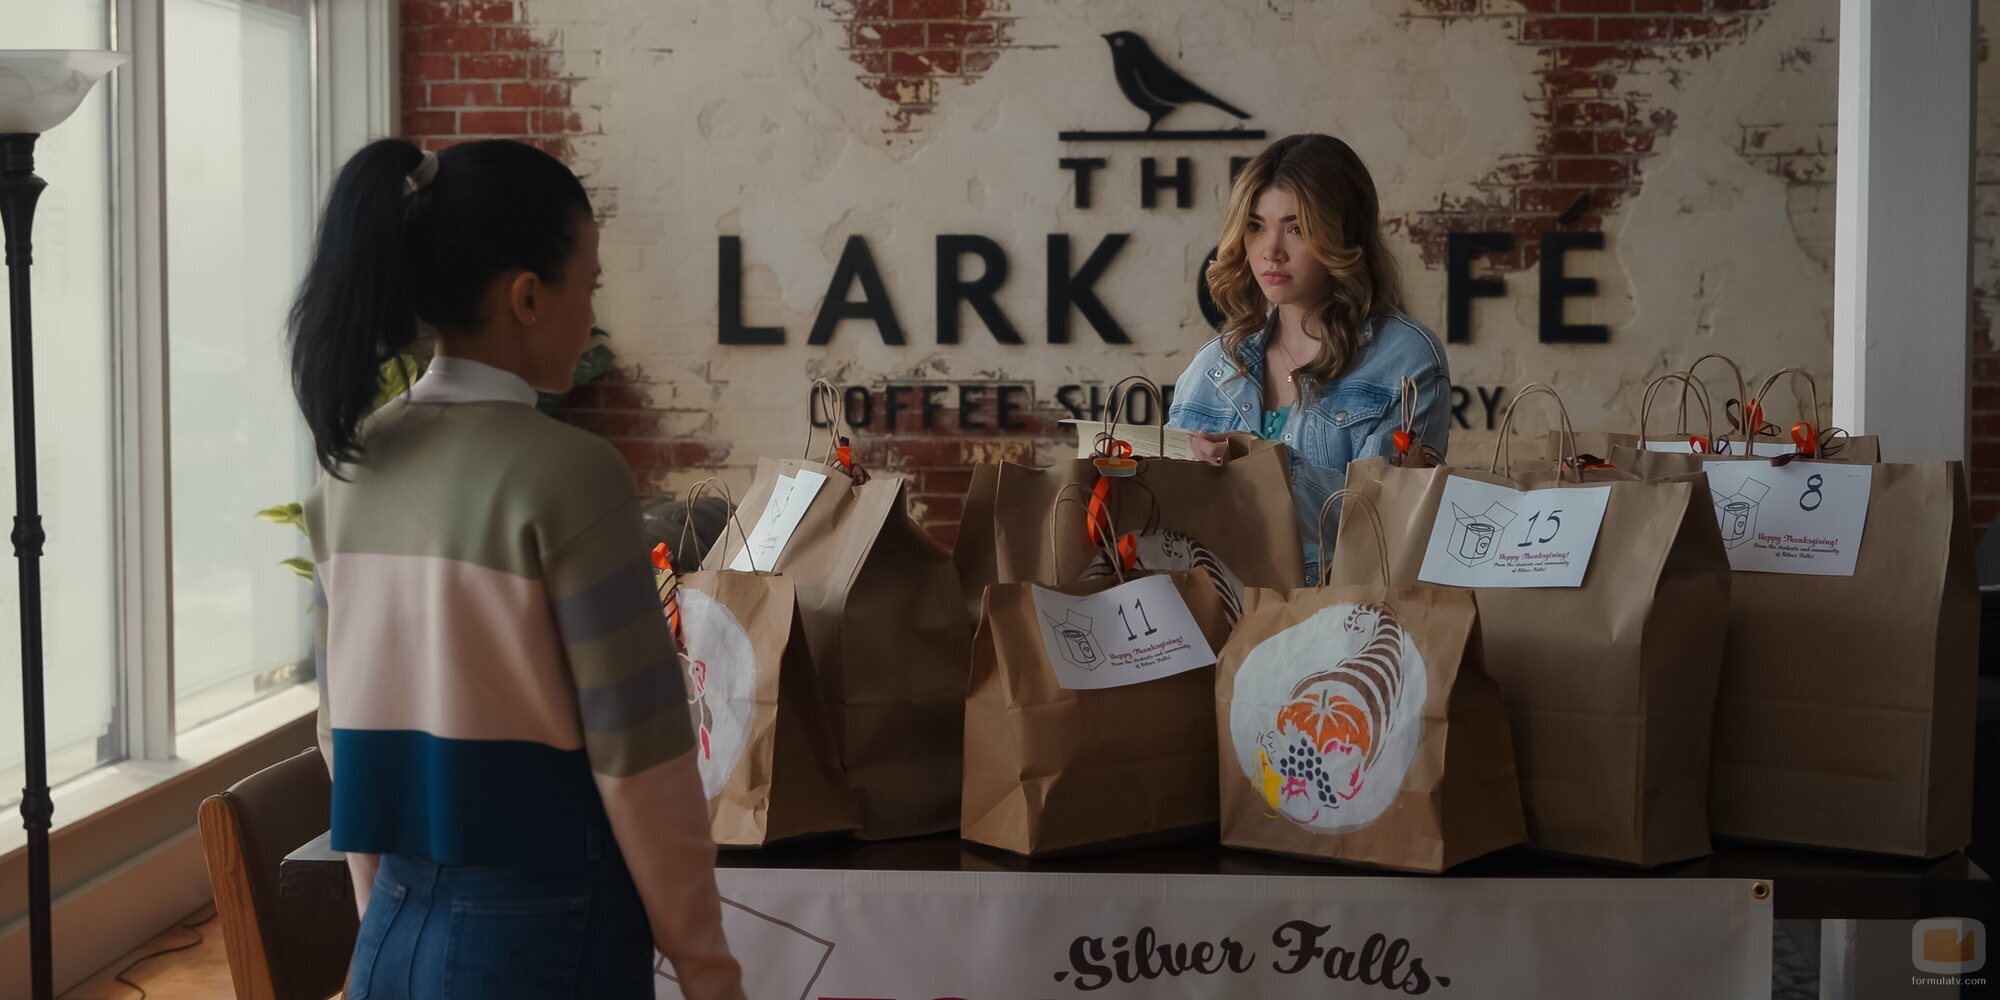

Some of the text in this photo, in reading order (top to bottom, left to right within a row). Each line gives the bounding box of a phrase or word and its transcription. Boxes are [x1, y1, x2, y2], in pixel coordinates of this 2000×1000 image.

[718, 234, 1133, 345] LARK
[810, 385, 1029, 429] COFFEE
[1800, 473, 1823, 511] 8
[1518, 509, 1563, 547] 15
[1758, 533, 1839, 548] Happy Thanksgiving!
[1499, 551, 1570, 563] Happy Thanksgiving!
[1118, 598, 1157, 641] 11
[1109, 636, 1184, 661] Happy Thanksgiving!
[1070, 920, 1431, 995] Silver Falls
